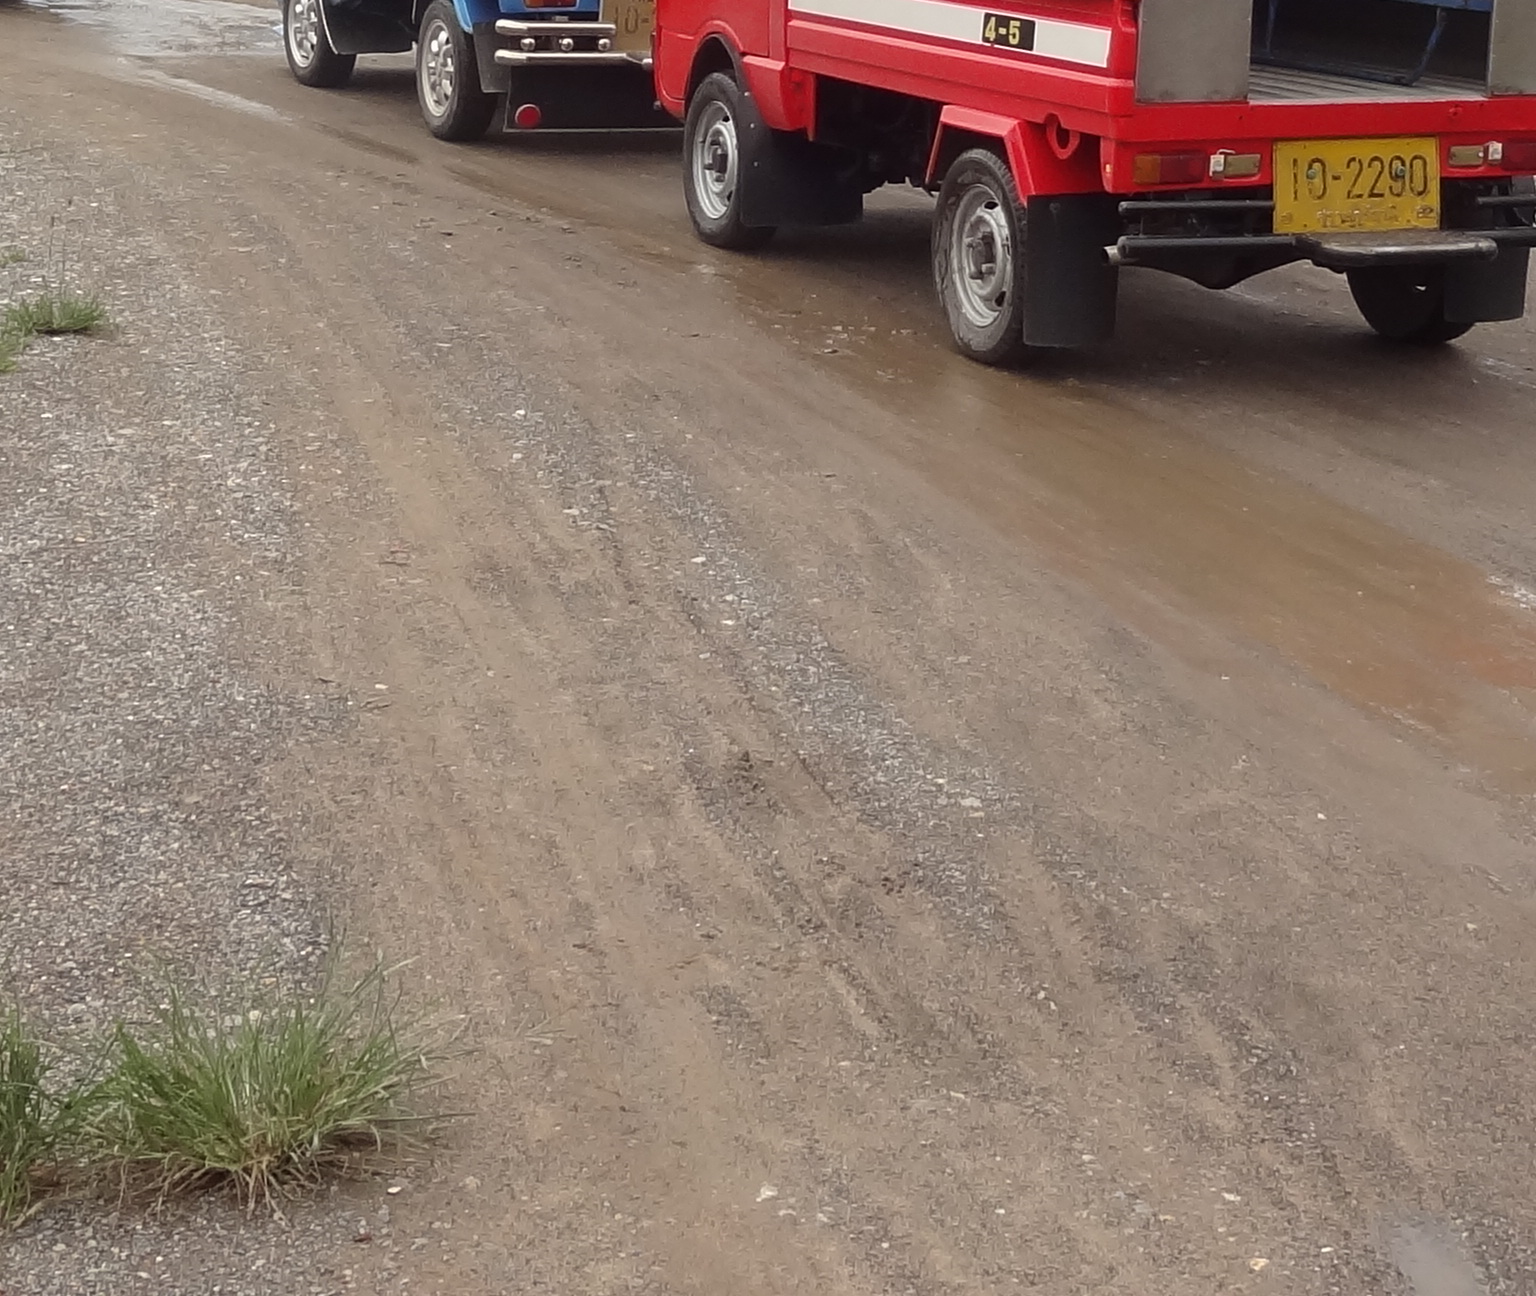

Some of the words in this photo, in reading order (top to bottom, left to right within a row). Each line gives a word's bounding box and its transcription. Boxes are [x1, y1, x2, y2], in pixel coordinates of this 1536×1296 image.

[615, 6, 656, 35] 10-
[984, 16, 1021, 45] 4-5
[1292, 154, 1428, 201] 10-2290
